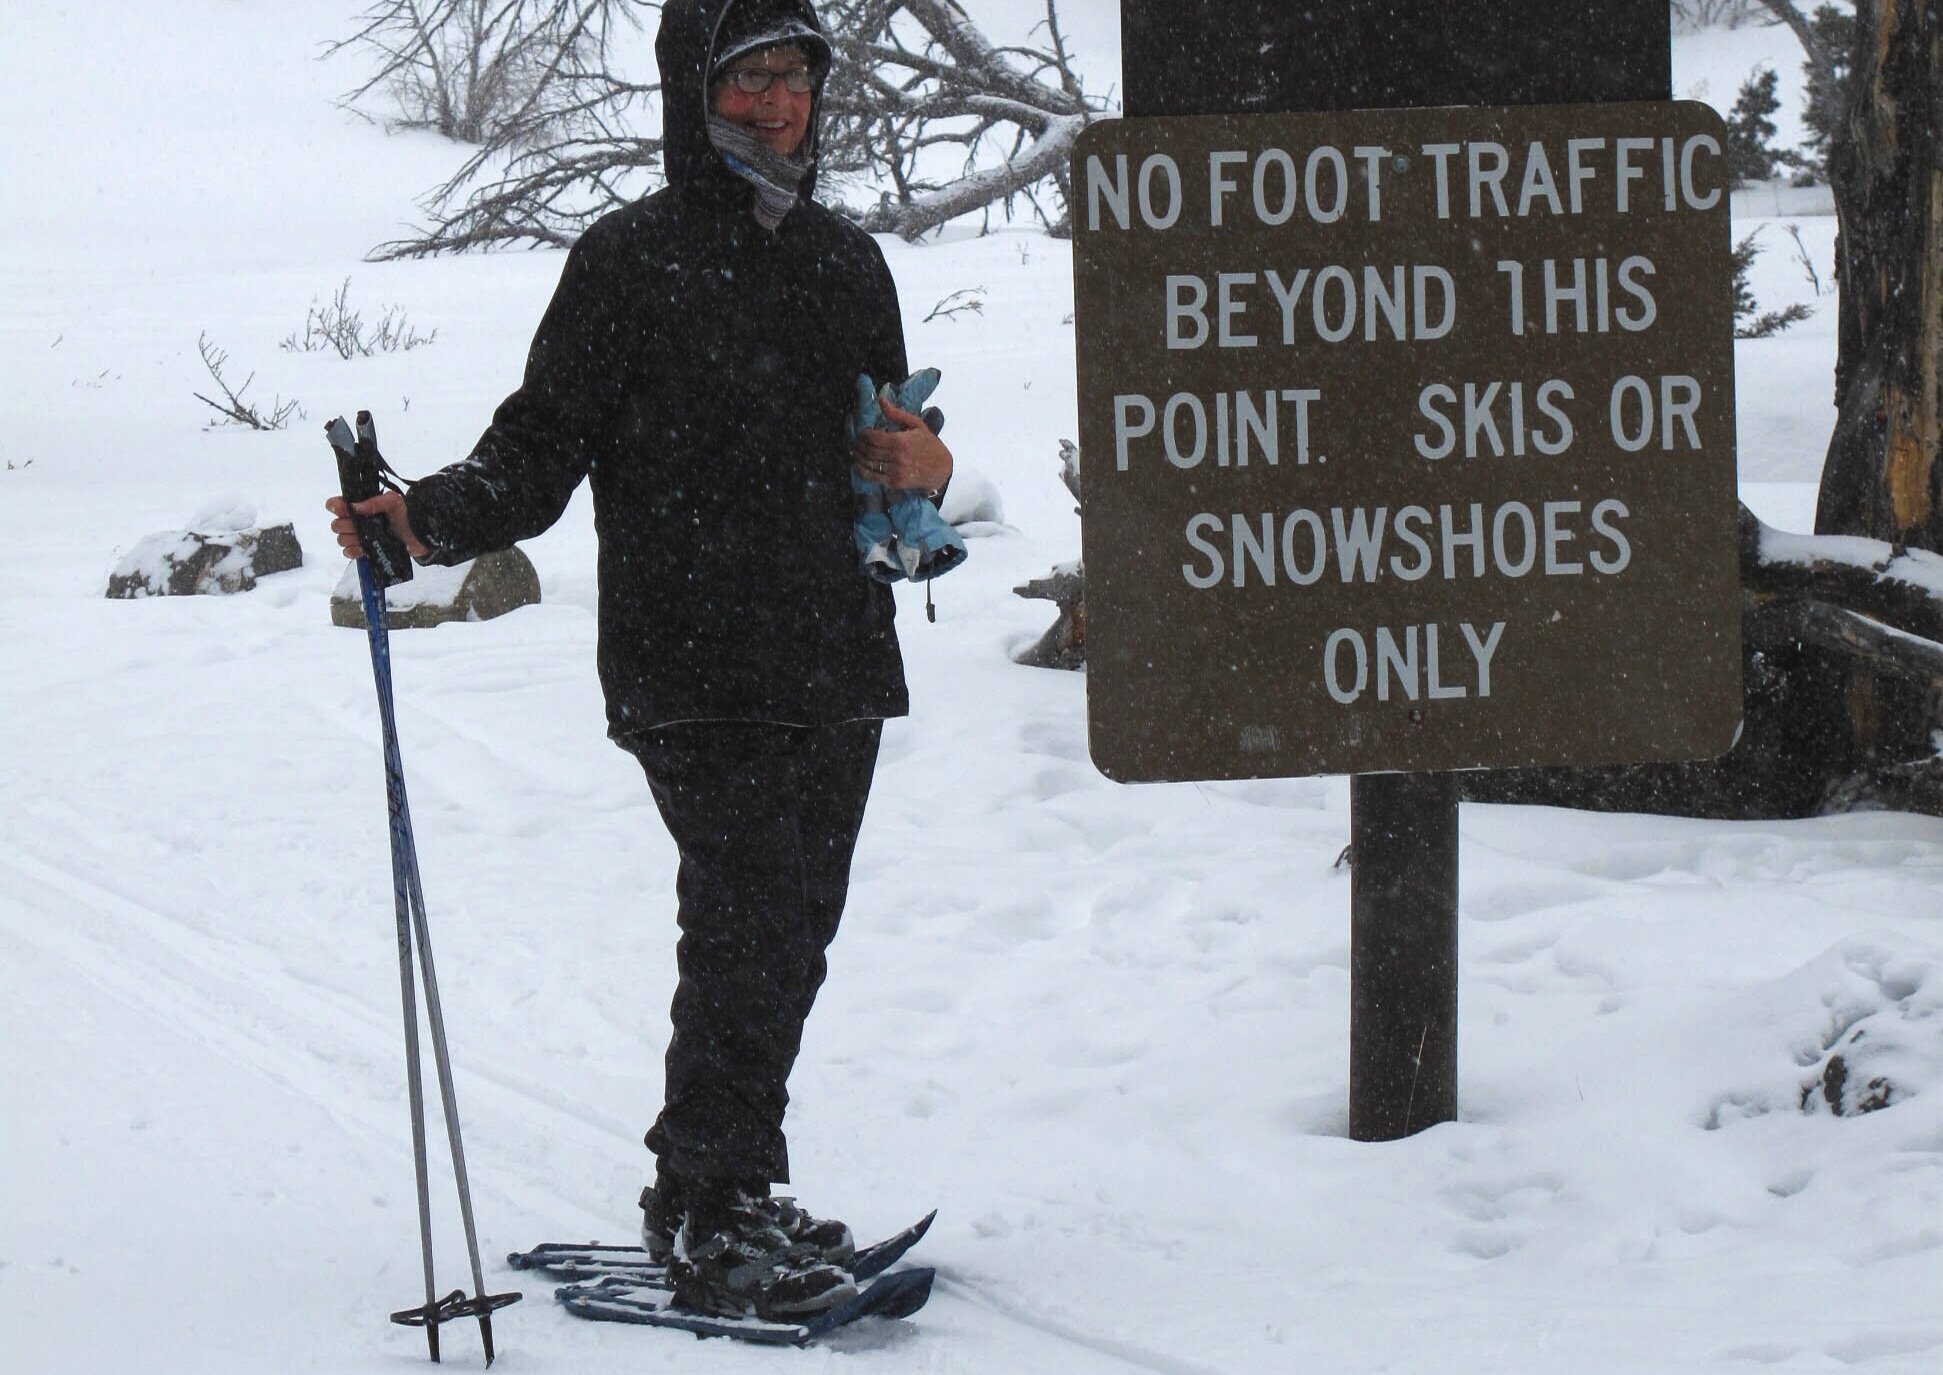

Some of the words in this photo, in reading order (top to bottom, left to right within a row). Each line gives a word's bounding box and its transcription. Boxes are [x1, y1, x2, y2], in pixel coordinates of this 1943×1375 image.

[1087, 154, 1181, 230] NO
[1210, 147, 1393, 225] FOOT
[1423, 134, 1722, 218] TRAFFIC
[1166, 265, 1456, 349] BEYOND
[1114, 389, 1327, 470] POINT.
[1414, 380, 1575, 459] SKIS
[1611, 375, 1702, 452] OR
[1182, 499, 1631, 588] SNOWSHOES
[1324, 622, 1505, 704] ONLY
